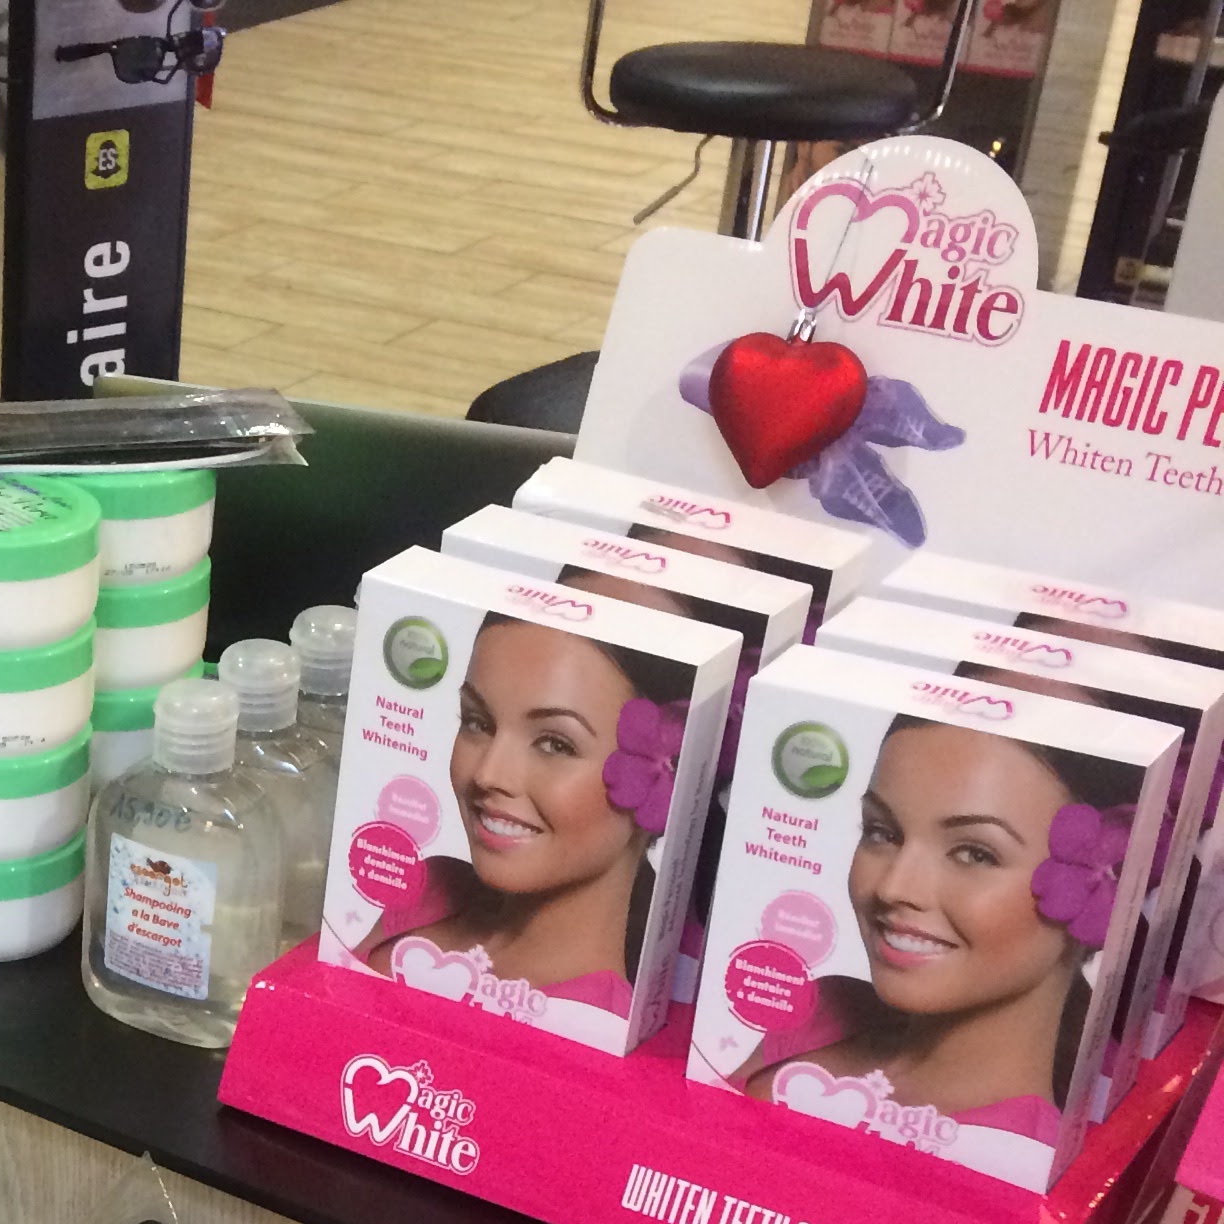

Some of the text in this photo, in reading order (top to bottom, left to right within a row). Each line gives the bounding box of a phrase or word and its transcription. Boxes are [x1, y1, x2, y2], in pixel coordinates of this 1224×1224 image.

[98, 147, 118, 171] ES
[796, 182, 1014, 263] Magic
[794, 238, 1020, 341] White
[1038, 339, 1185, 436] MAGIC
[1028, 428, 1224, 497] Whiten Teeth
[376, 695, 425, 720] Natural
[380, 715, 416, 737] Teeth
[362, 728, 429, 762] Whitening
[762, 806, 819, 831] Natural
[767, 827, 808, 849] Teeth
[745, 841, 823, 875] Whitening
[124, 886, 192, 918] Shampooing
[127, 921, 183, 948] d'escargot
[140, 909, 150, 922] la
[152, 914, 180, 930] Bave
[344, 1057, 474, 1122] Magic
[777, 1064, 955, 1141] Magic
[343, 1087, 478, 1172] White
